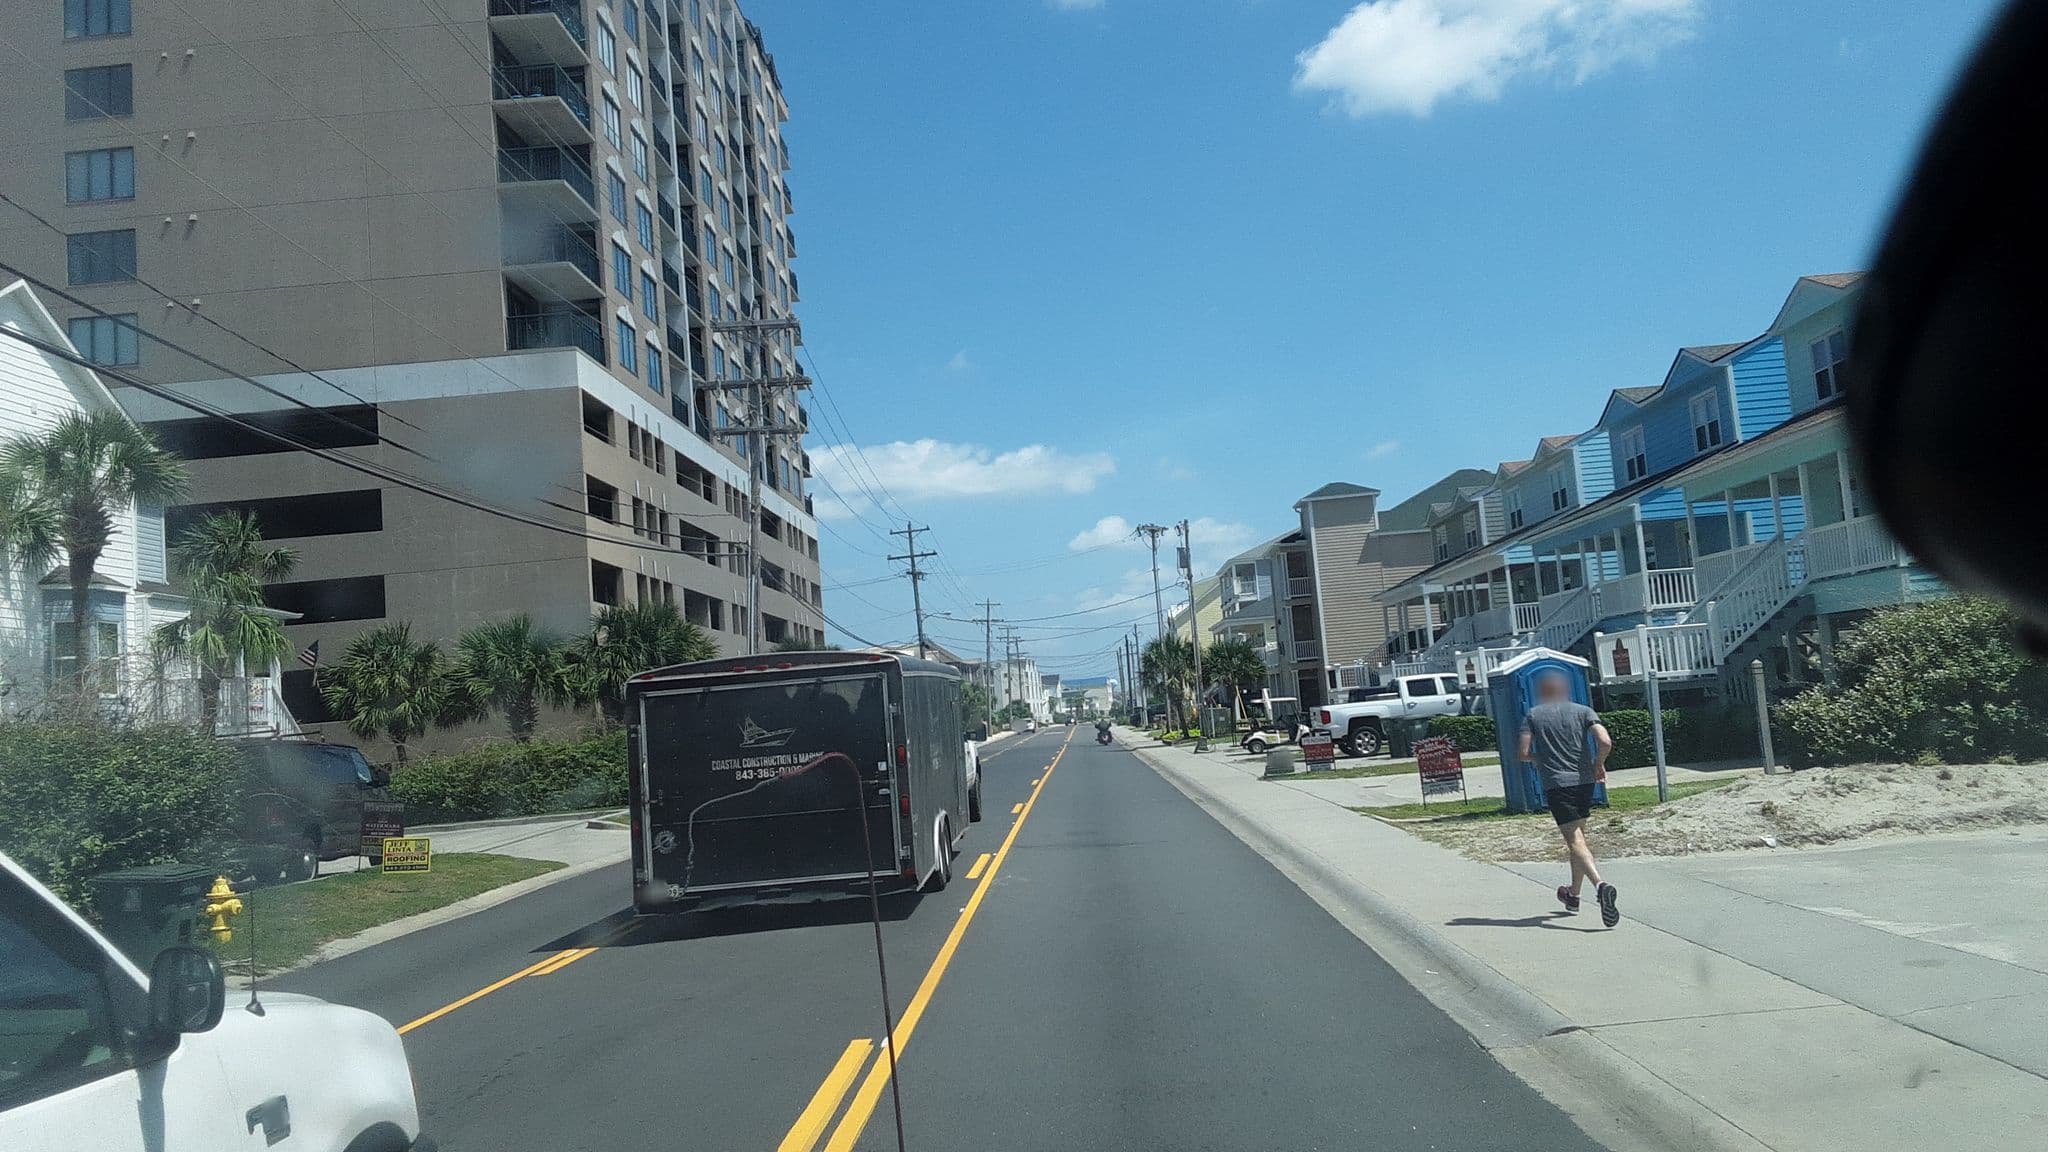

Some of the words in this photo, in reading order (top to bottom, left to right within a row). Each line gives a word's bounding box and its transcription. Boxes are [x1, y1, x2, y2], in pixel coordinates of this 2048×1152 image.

[711, 758, 742, 771] COASTAL
[742, 754, 791, 768] CONSTRUCTION
[792, 753, 798, 764] &
